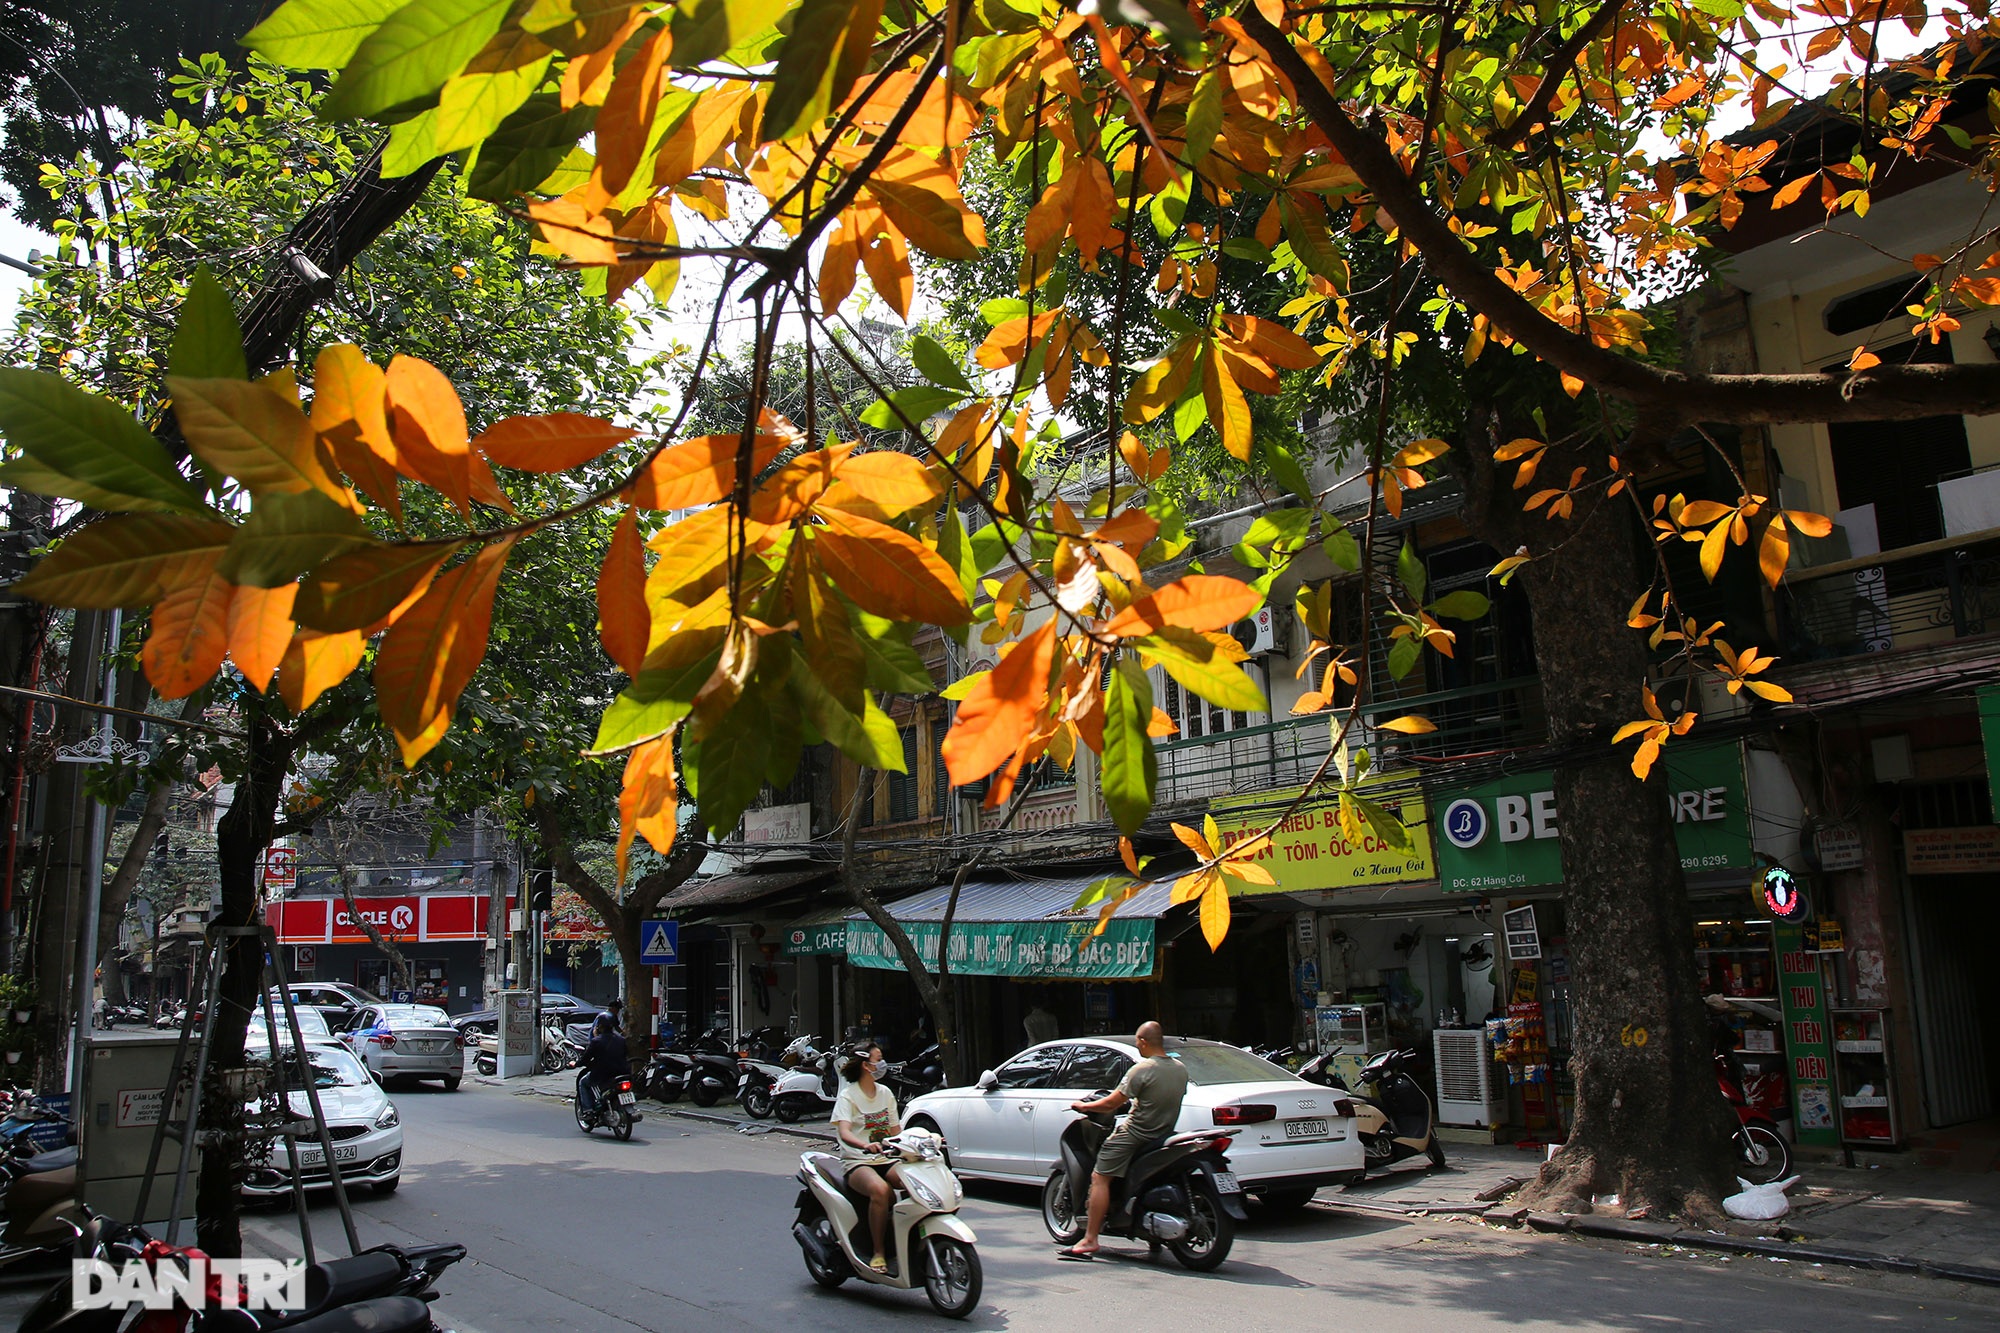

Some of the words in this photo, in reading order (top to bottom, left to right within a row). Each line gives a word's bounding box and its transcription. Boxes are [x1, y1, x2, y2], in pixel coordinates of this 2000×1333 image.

[1260, 625, 1269, 633] LG
[1284, 840, 1318, 862] TÔM
[1329, 832, 1353, 857] ỐC
[1353, 866, 1365, 877] 62
[1369, 862, 1402, 875] Hàng
[1471, 877, 1481, 886] 62
[1483, 875, 1507, 887] Hàng
[1509, 873, 1526, 884] Cót
[793, 932, 803, 944] 66
[816, 928, 845, 950] CAFÉ
[974, 935, 990, 968] MỌC
[1018, 935, 1045, 964] PHỞ
[1051, 938, 1071, 964] BÒ
[1791, 986, 1815, 1008] THU
[1620, 1023, 1649, 1047] 60
[1796, 1054, 1828, 1084] ĐIỆN
[1287, 1122, 1327, 1136] 30E-600.24
[304, 1147, 355, 1163] 30F-9.24
